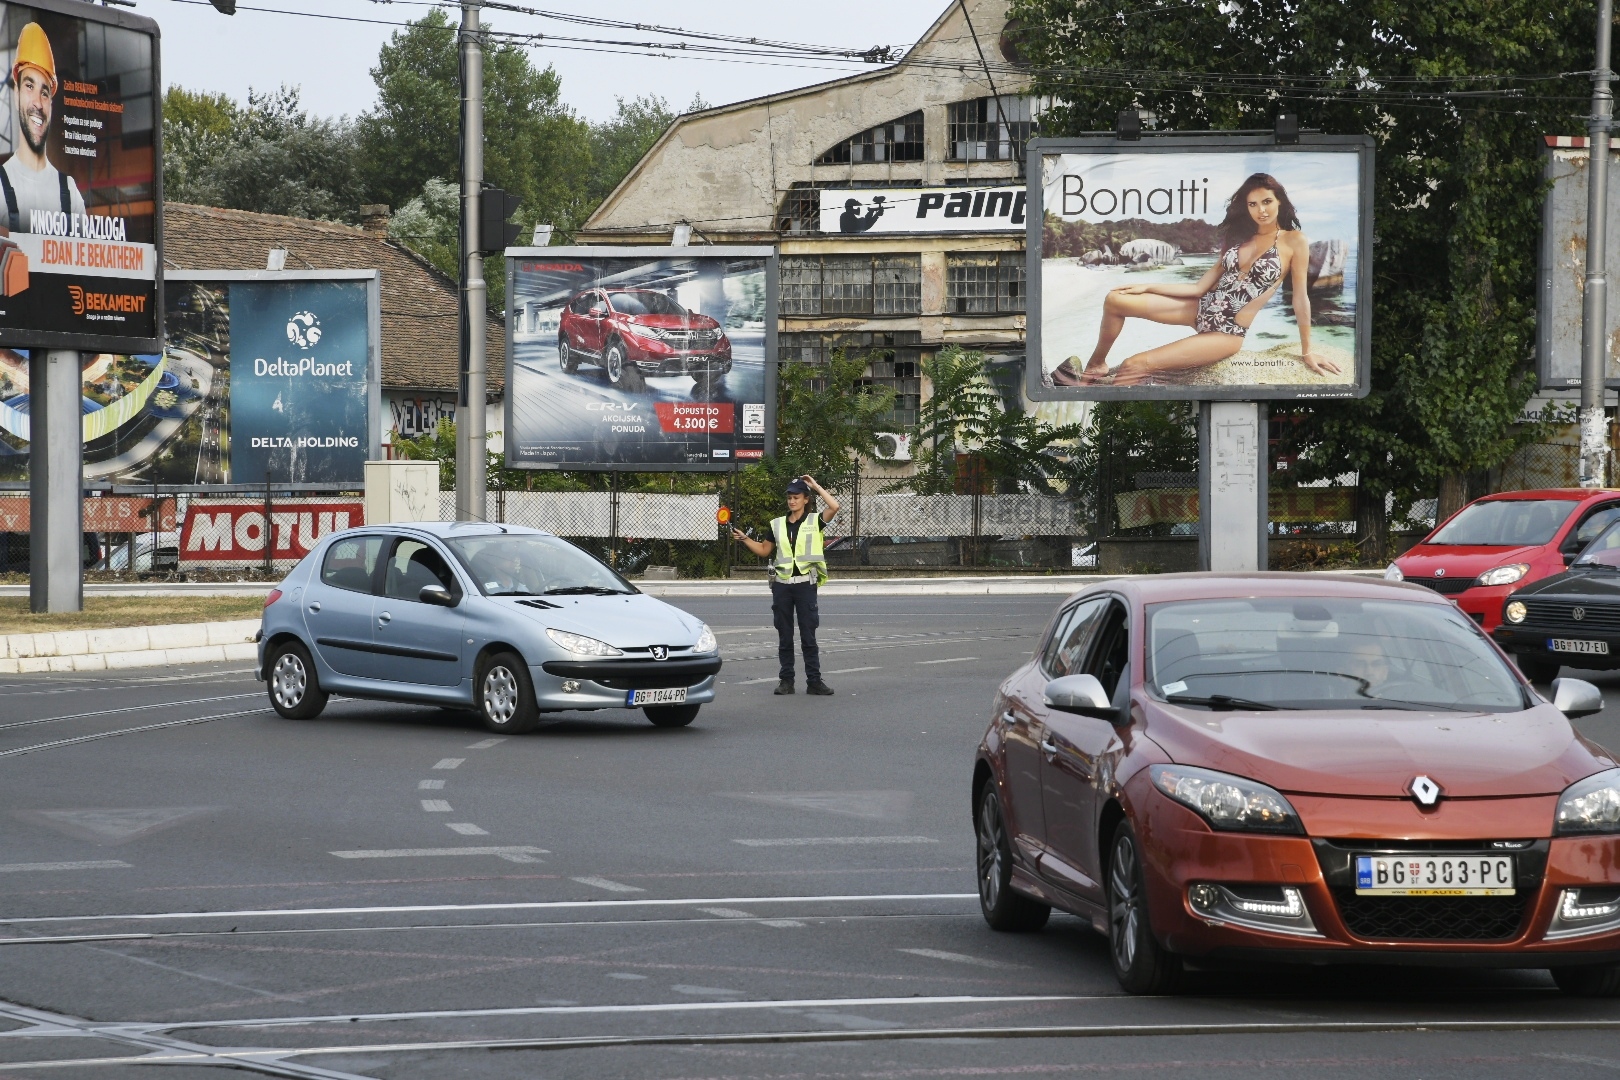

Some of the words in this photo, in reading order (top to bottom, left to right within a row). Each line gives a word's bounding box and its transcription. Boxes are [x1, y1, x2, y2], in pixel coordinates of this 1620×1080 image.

[1063, 174, 1209, 215] Bonatti
[30, 209, 67, 236] MNOGO
[70, 213, 80, 237] JE
[83, 214, 126, 241] RAZLOGA
[41, 240, 72, 265] JEDAN
[75, 242, 85, 266] JE
[88, 243, 143, 270] BEKATHERM
[534, 264, 584, 272] HONDA
[86, 293, 145, 312] BEKAMENT
[254, 357, 353, 376] DeltaPlanet
[586, 403, 638, 411] CR-V
[602, 415, 642, 423] AKCIJSKA
[674, 418, 706, 429] 4.300
[252, 437, 292, 447] DELTA
[298, 437, 358, 447] HOLDING
[1554, 640, 1566, 650] BG
[635, 691, 646, 703] BG
[1377, 860, 1404, 884] BG
